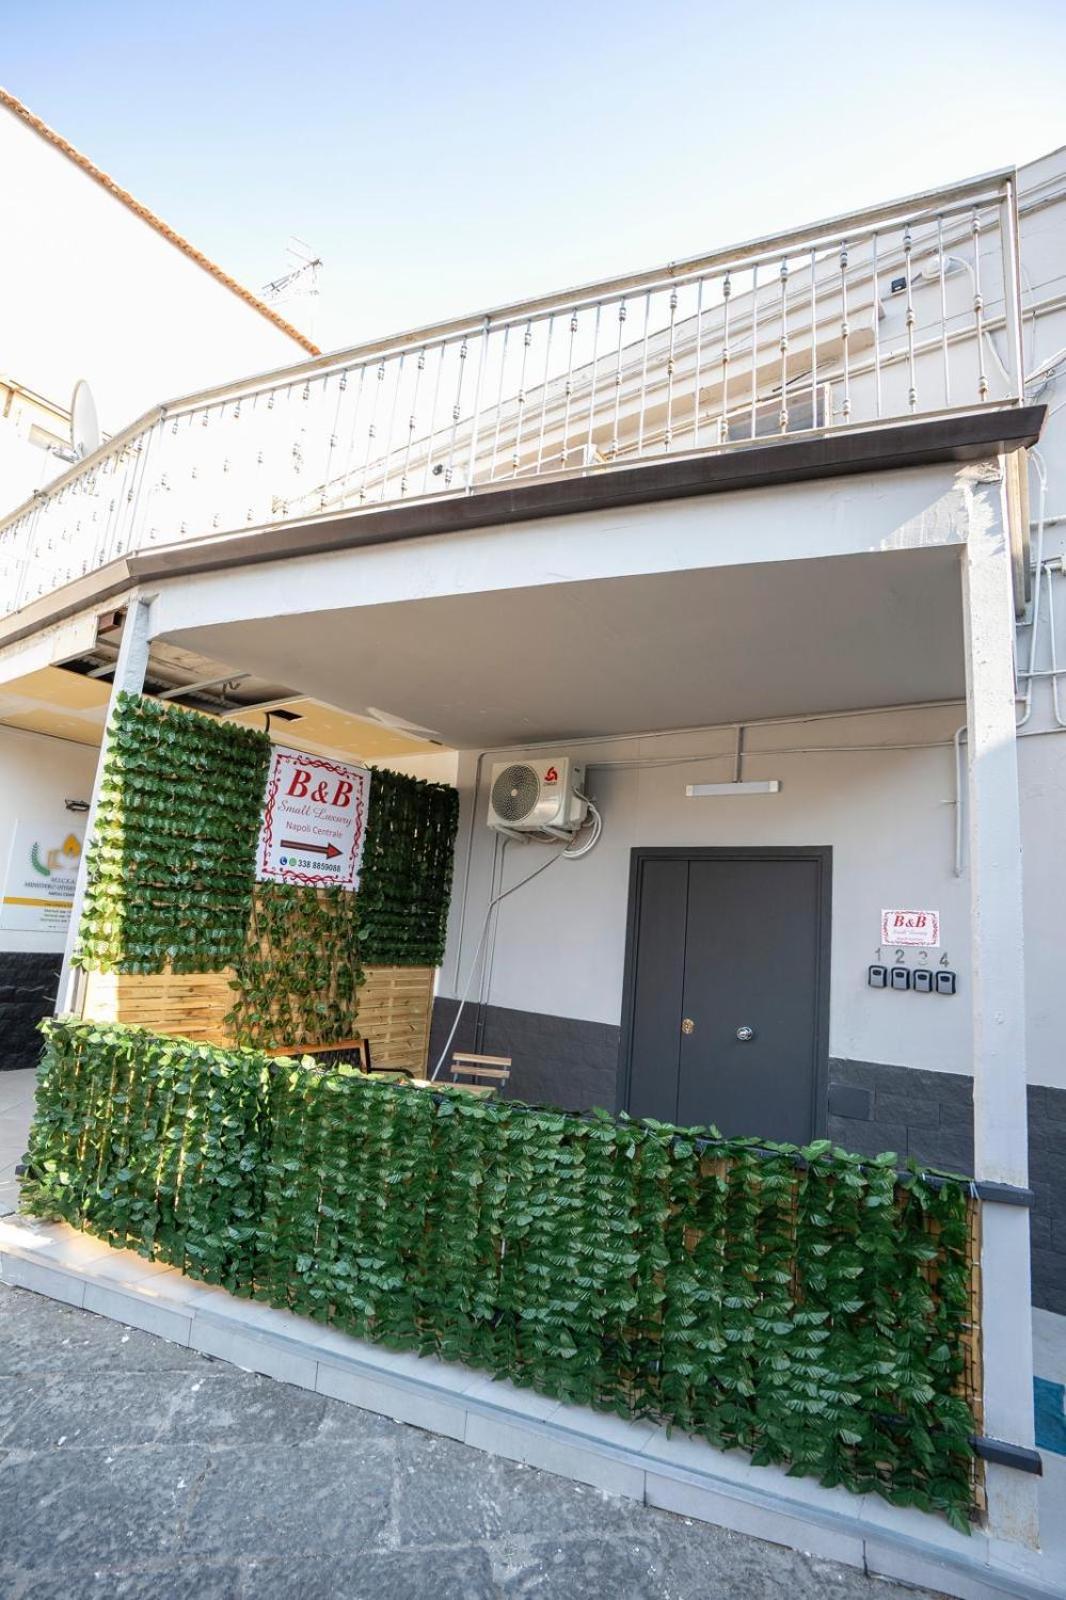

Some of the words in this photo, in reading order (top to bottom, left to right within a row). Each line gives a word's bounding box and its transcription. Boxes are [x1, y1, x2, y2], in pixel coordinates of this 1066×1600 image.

[286, 769, 353, 808] B&B
[278, 799, 311, 818] Small
[312, 808, 352, 828] Luxury
[286, 820, 311, 833] Napoli
[312, 826, 343, 839] Centrale
[893, 915, 927, 928] B&B
[875, 947, 881, 962] 1
[895, 949, 905, 964] 2
[918, 950, 928, 966] 3
[939, 952, 950, 968] 4
